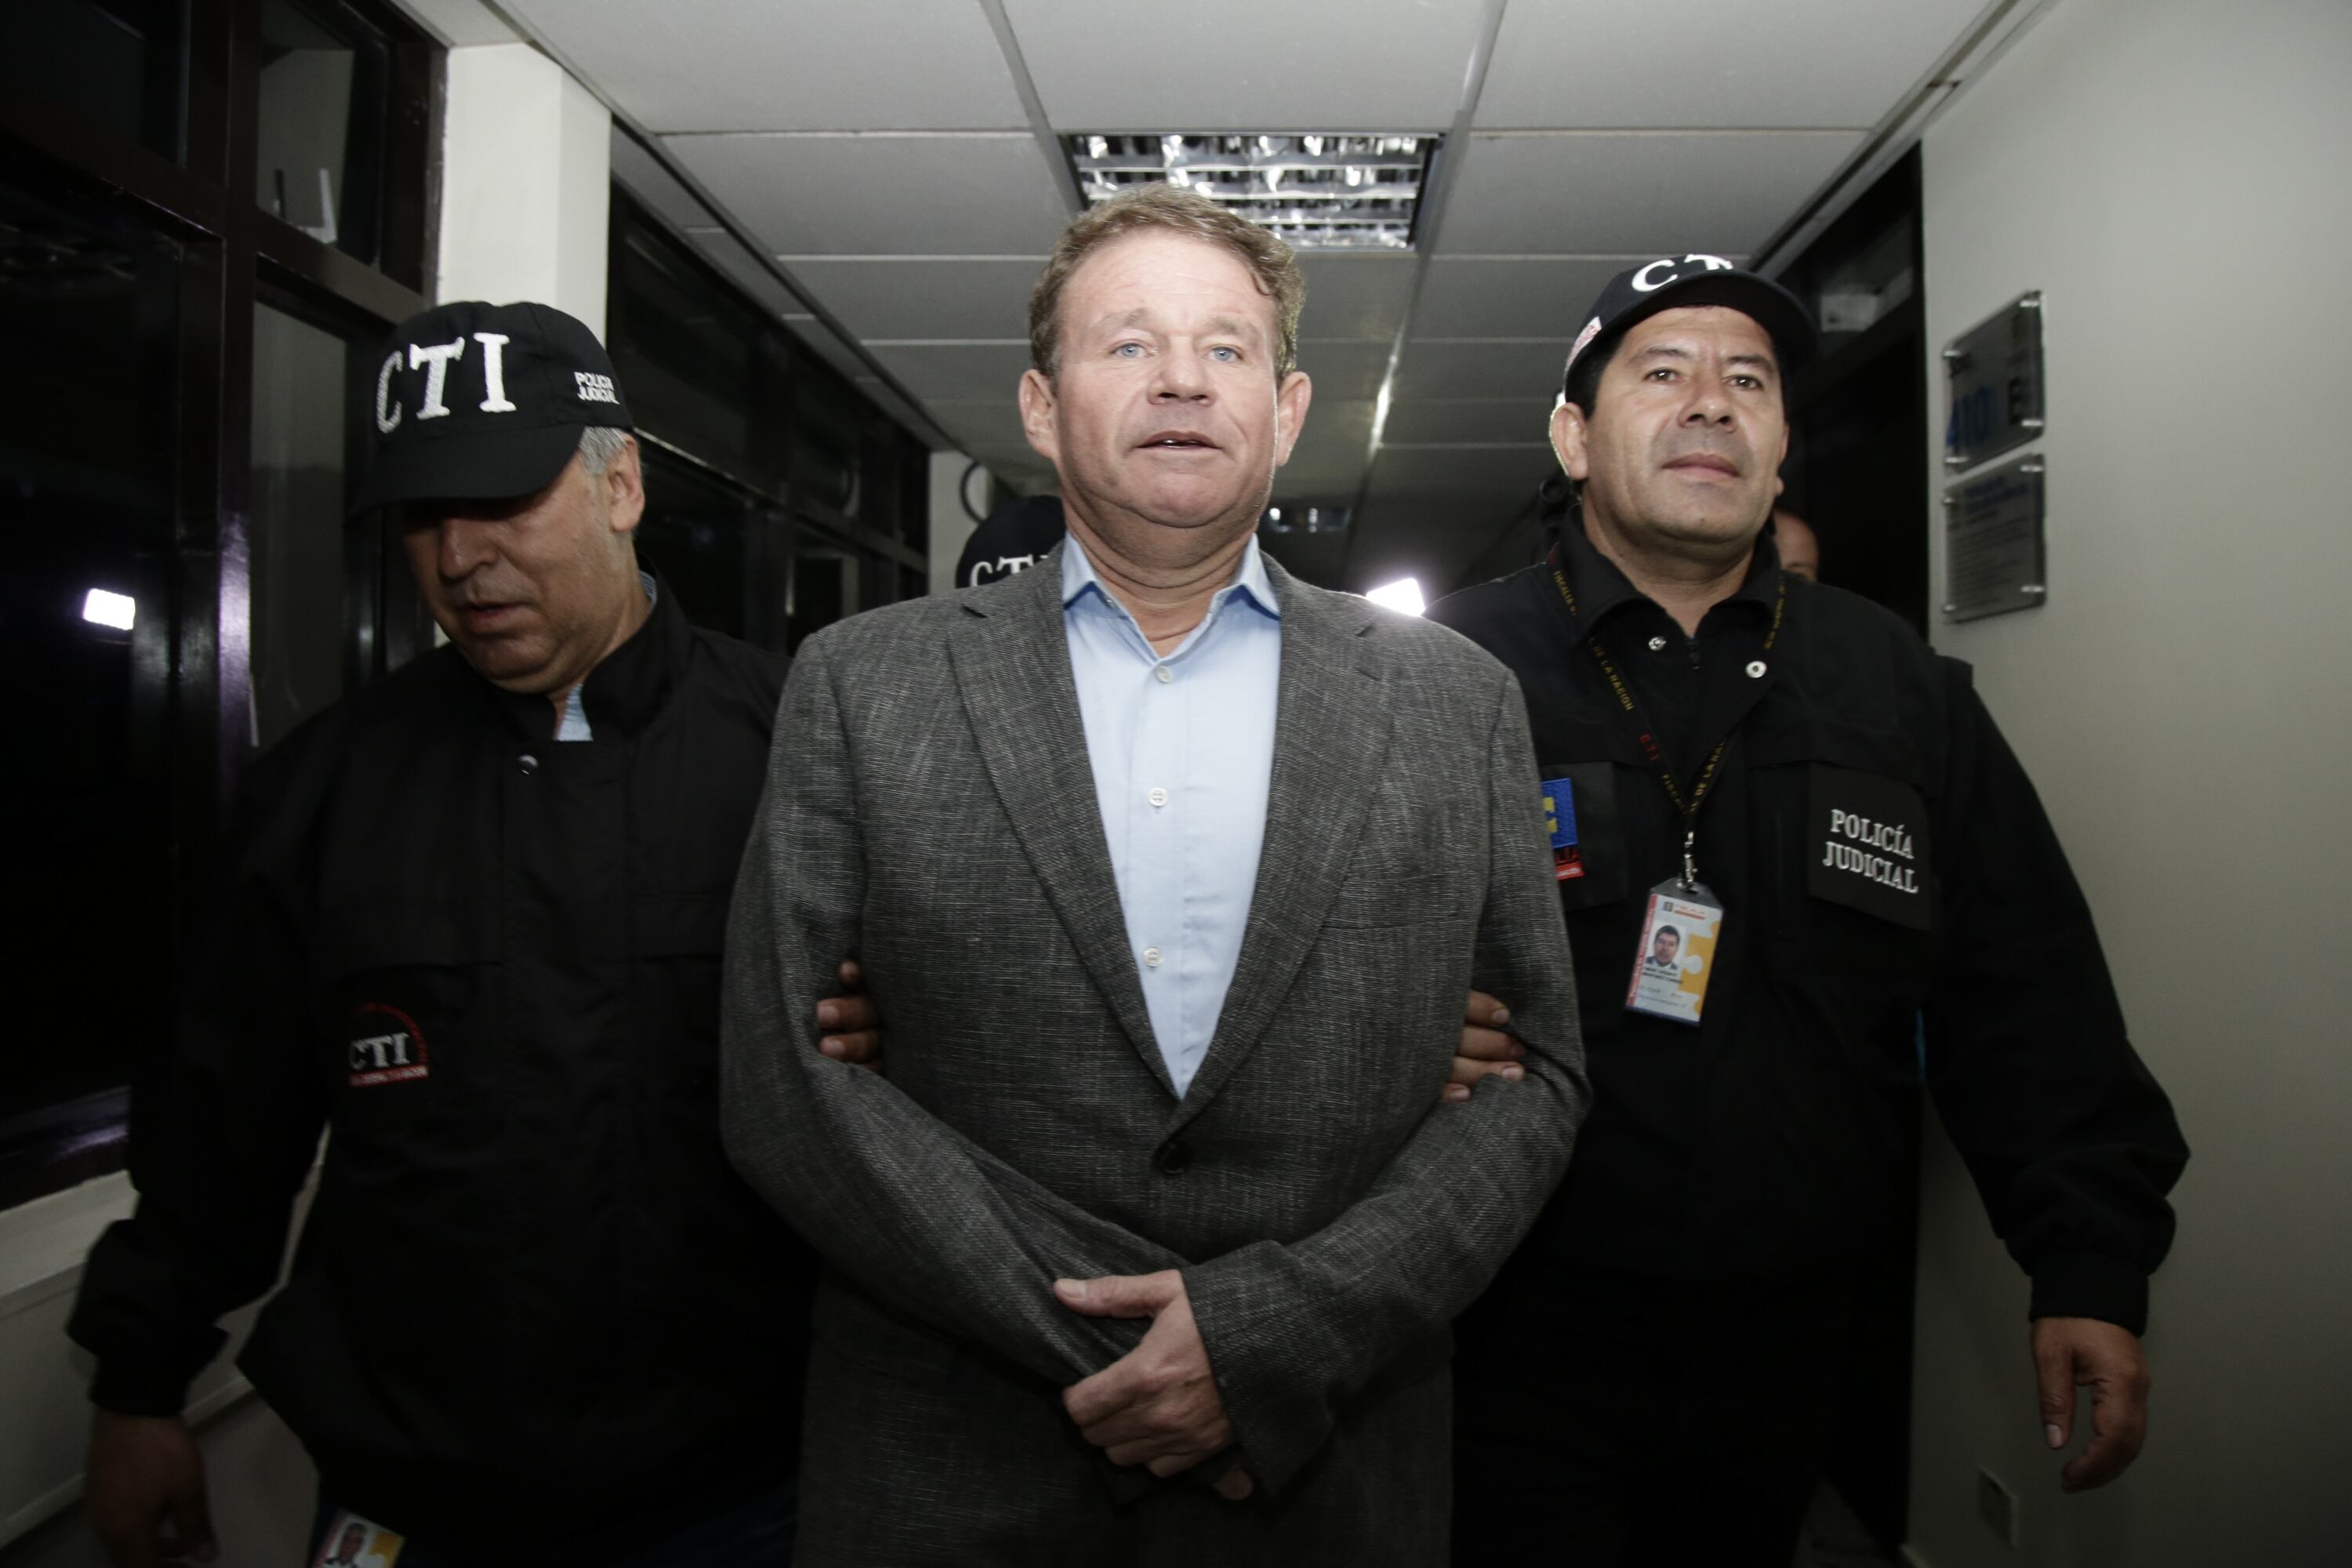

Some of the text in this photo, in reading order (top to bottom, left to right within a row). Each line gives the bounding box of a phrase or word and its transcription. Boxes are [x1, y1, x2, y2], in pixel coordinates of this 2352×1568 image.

[376, 332, 517, 434] CTI
[969, 553, 1049, 588] CT
[1829, 808, 1915, 860] POLICÍA
[1822, 840, 1919, 895] JUDICIAL
[349, 1032, 410, 1070] CTI
